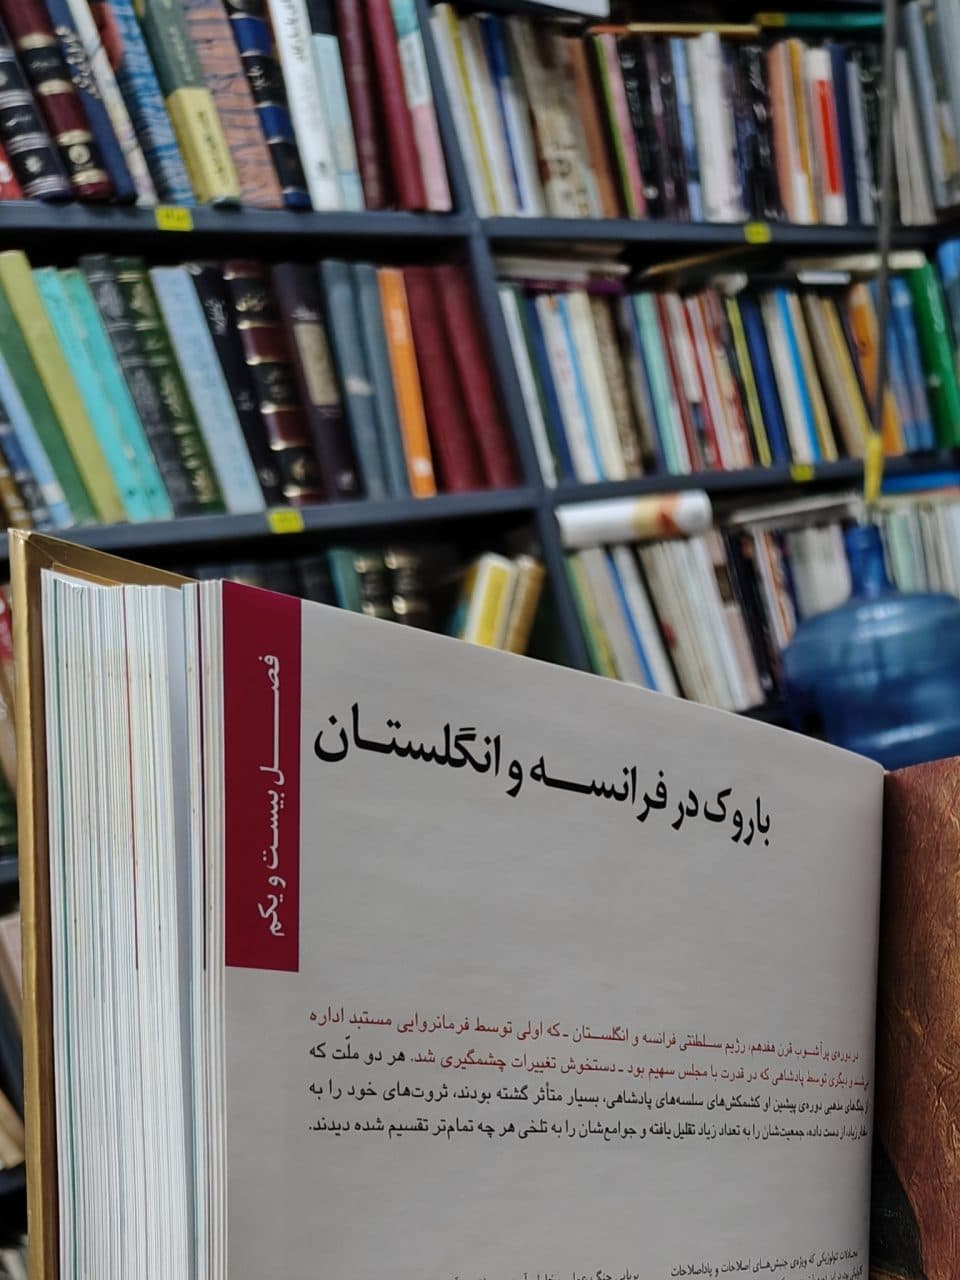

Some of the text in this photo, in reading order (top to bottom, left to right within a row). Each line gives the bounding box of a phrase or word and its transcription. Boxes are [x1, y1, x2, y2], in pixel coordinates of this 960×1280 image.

[314, 702, 771, 846] باروک در فرانسه و انگلستان
[258, 654, 286, 937] فصل بیست و یکم
[310, 1006, 344, 1026] اداره
[349, 1011, 392, 1029] مستبد
[397, 1012, 470, 1035] فرمانروایی
[474, 1017, 512, 1038] توسط
[517, 1020, 542, 1040] اولی
[573, 1025, 628, 1043] انگلستان
[632, 1036, 639, 1047] و
[643, 1032, 676, 1048] فرانسه
[679, 1034, 722, 1051] سلطنتی
[725, 1038, 745, 1056] رژیم
[309, 1042, 326, 1058] که
[367, 1051, 382, 1065] دو
[387, 1051, 405, 1066] هر
[411, 1049, 435, 1063] شد.
[440, 1049, 506, 1072] چشمگیری
[511, 1053, 556, 1073] تغییرات
[561, 1057, 615, 1075] دستخوش
[627, 1065, 644, 1078] بود
[648, 1067, 675, 1080] سهیم
[678, 1064, 708, 1080] مجلس
[711, 1065, 717, 1082] با
[721, 1067, 744, 1082] قدرت
[747, 1072, 757, 1083] در
[309, 1083, 323, 1100] به
[329, 1078, 342, 1100] را
[347, 1082, 377, 1101] خود
[453, 1086, 491, 1104] بودند،
[496, 1085, 528, 1100] گشته
[566, 1088, 599, 1107] بسیار
[309, 1117, 350, 1136] دیدند.
[354, 1117, 384, 1131] شده
[388, 1118, 429, 1139] تقسیم
[477, 1122, 495, 1138] چه
[499, 1123, 515, 1137] هر
[518, 1119, 548, 1139] تلخی
[551, 1124, 562, 1138] به
[565, 1120, 575, 1138] را
[699, 1122, 716, 1140] زیاد
[719, 1123, 740, 1136] تعداد
